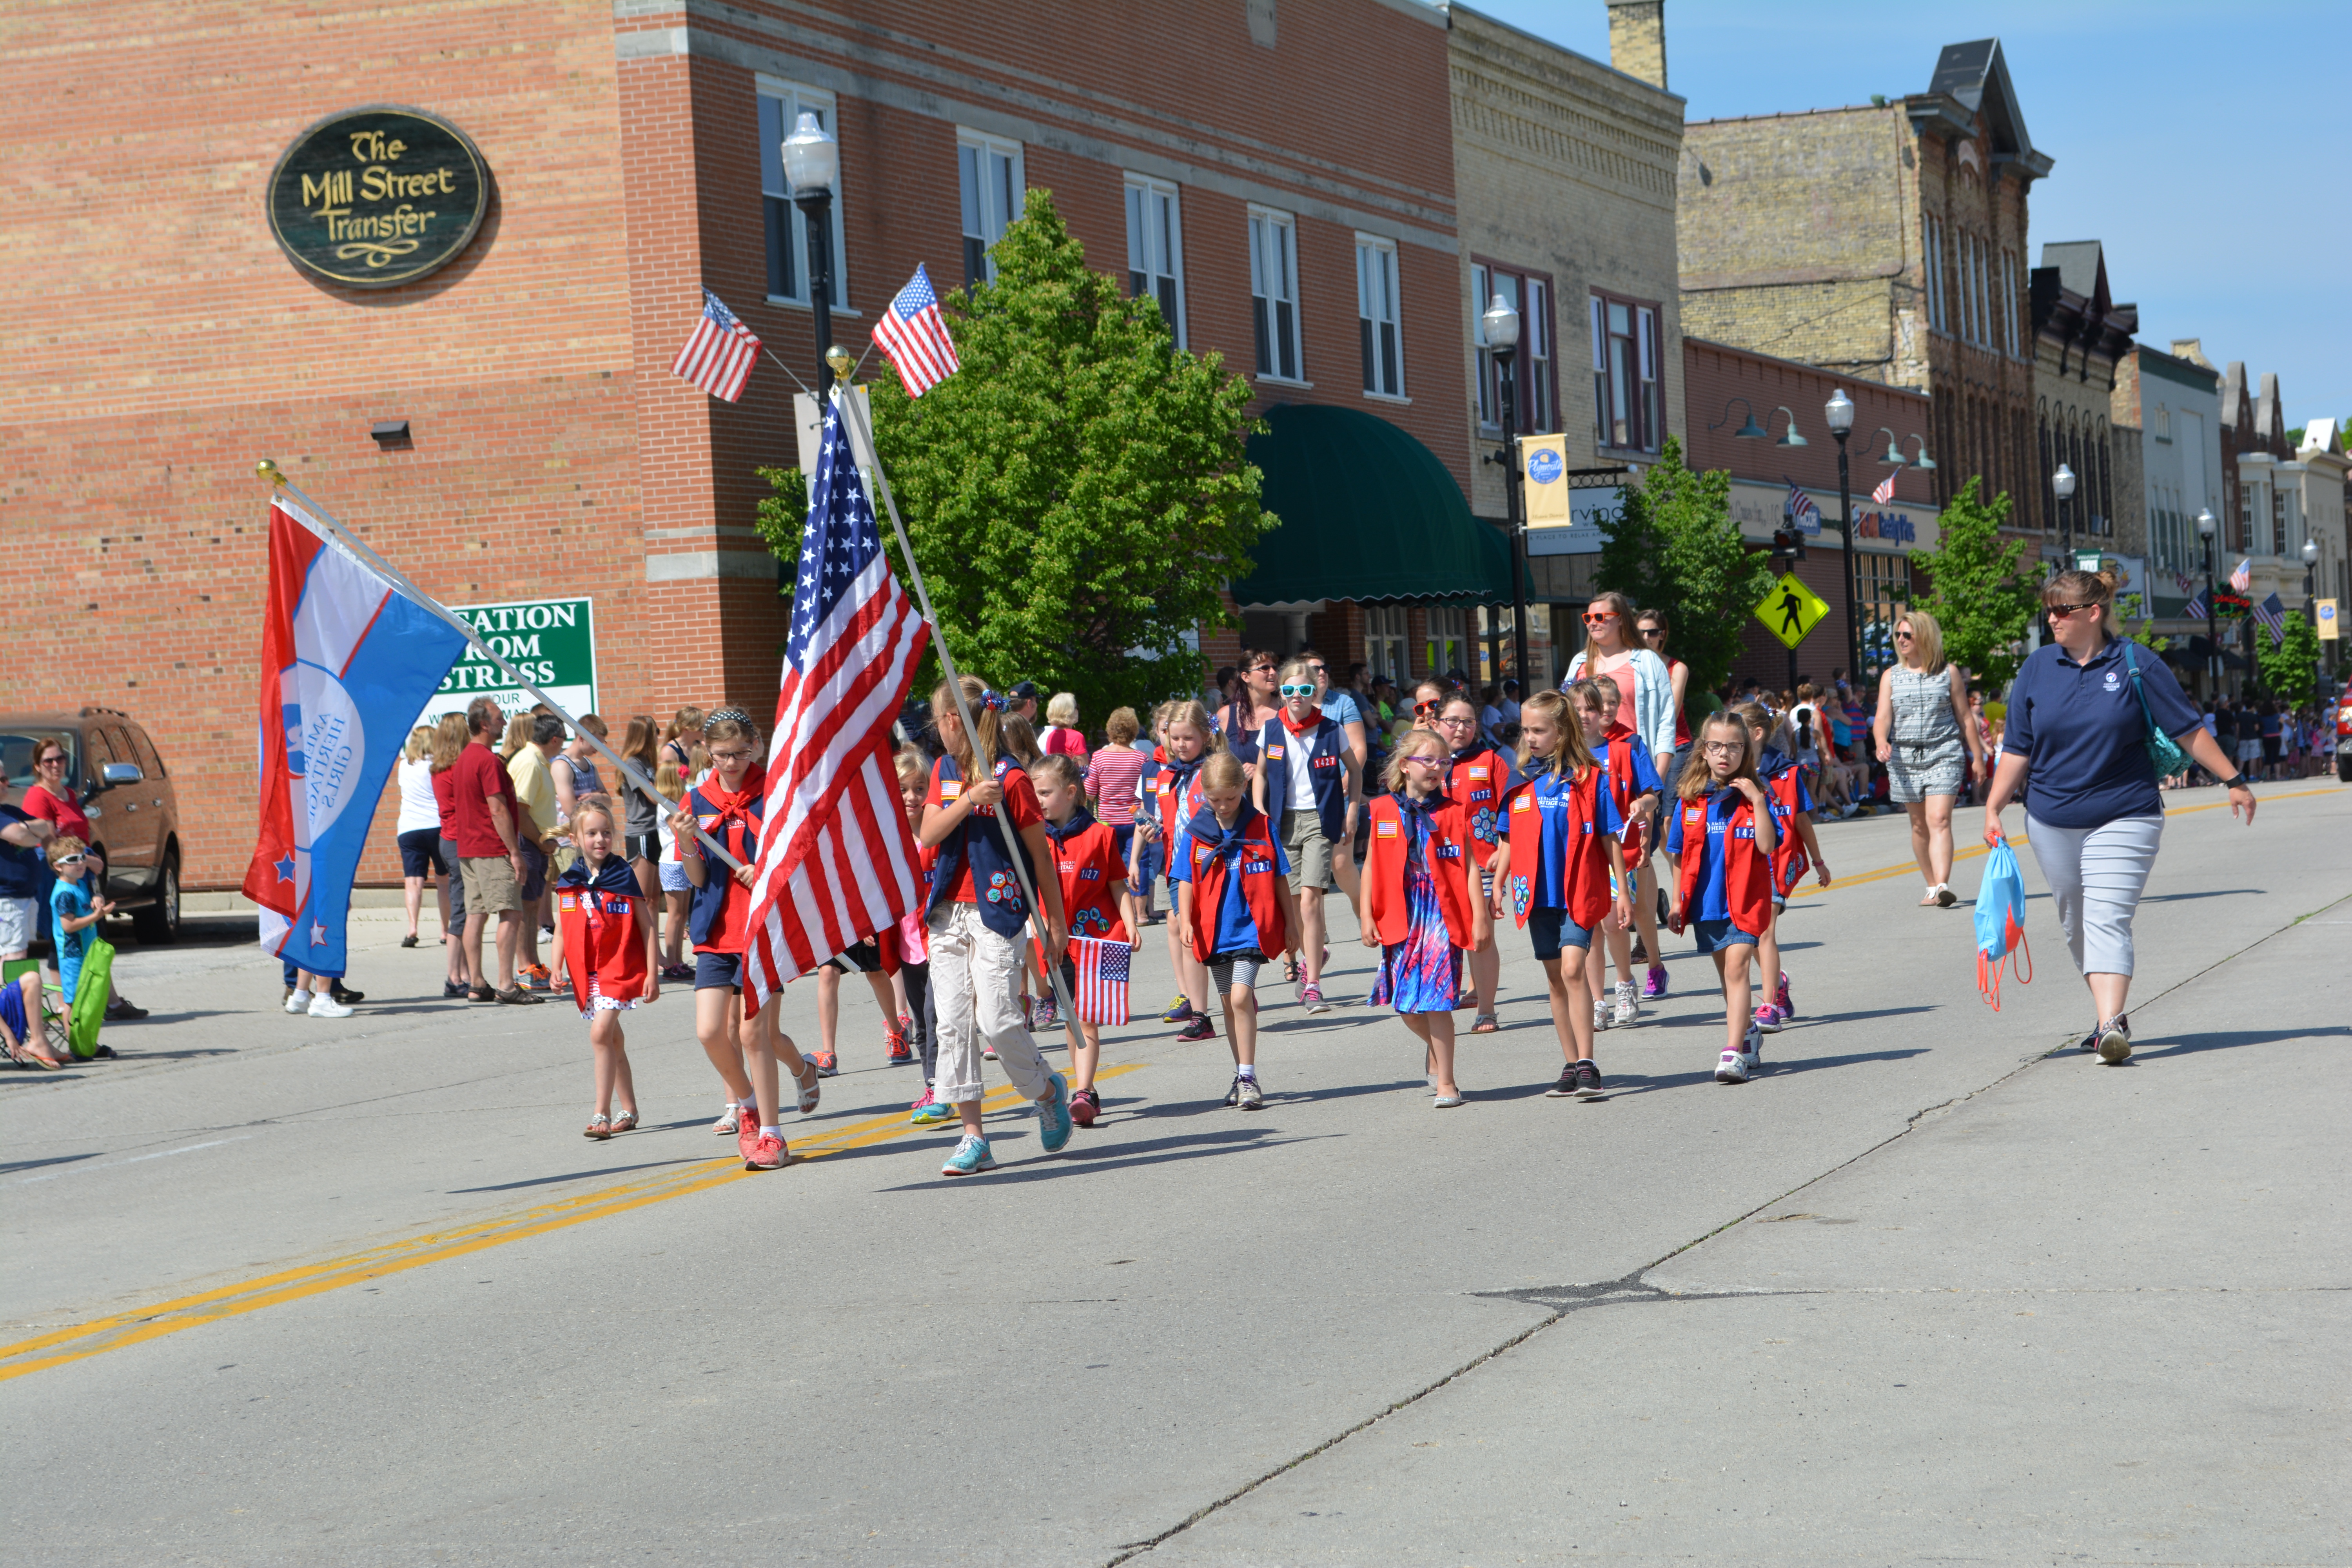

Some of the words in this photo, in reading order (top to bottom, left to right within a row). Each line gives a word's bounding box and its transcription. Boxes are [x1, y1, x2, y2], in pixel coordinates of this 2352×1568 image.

[350, 130, 408, 162] The
[301, 170, 354, 208] Mill
[360, 165, 456, 201] Street
[311, 204, 436, 241] Transfer
[1528, 458, 1563, 479] Plymouth
[455, 604, 576, 632] ATION
[463, 634, 542, 661] ROM
[1315, 757, 1335, 768] 1427
[1471, 789, 1491, 800] 1472
[976, 804, 995, 815] 142
[1774, 805, 1790, 816] 427
[1736, 828, 1754, 838] 142
[1437, 846, 1459, 857] 1427
[1246, 860, 1270, 873] 1427
[607, 903, 628, 913] 1427
